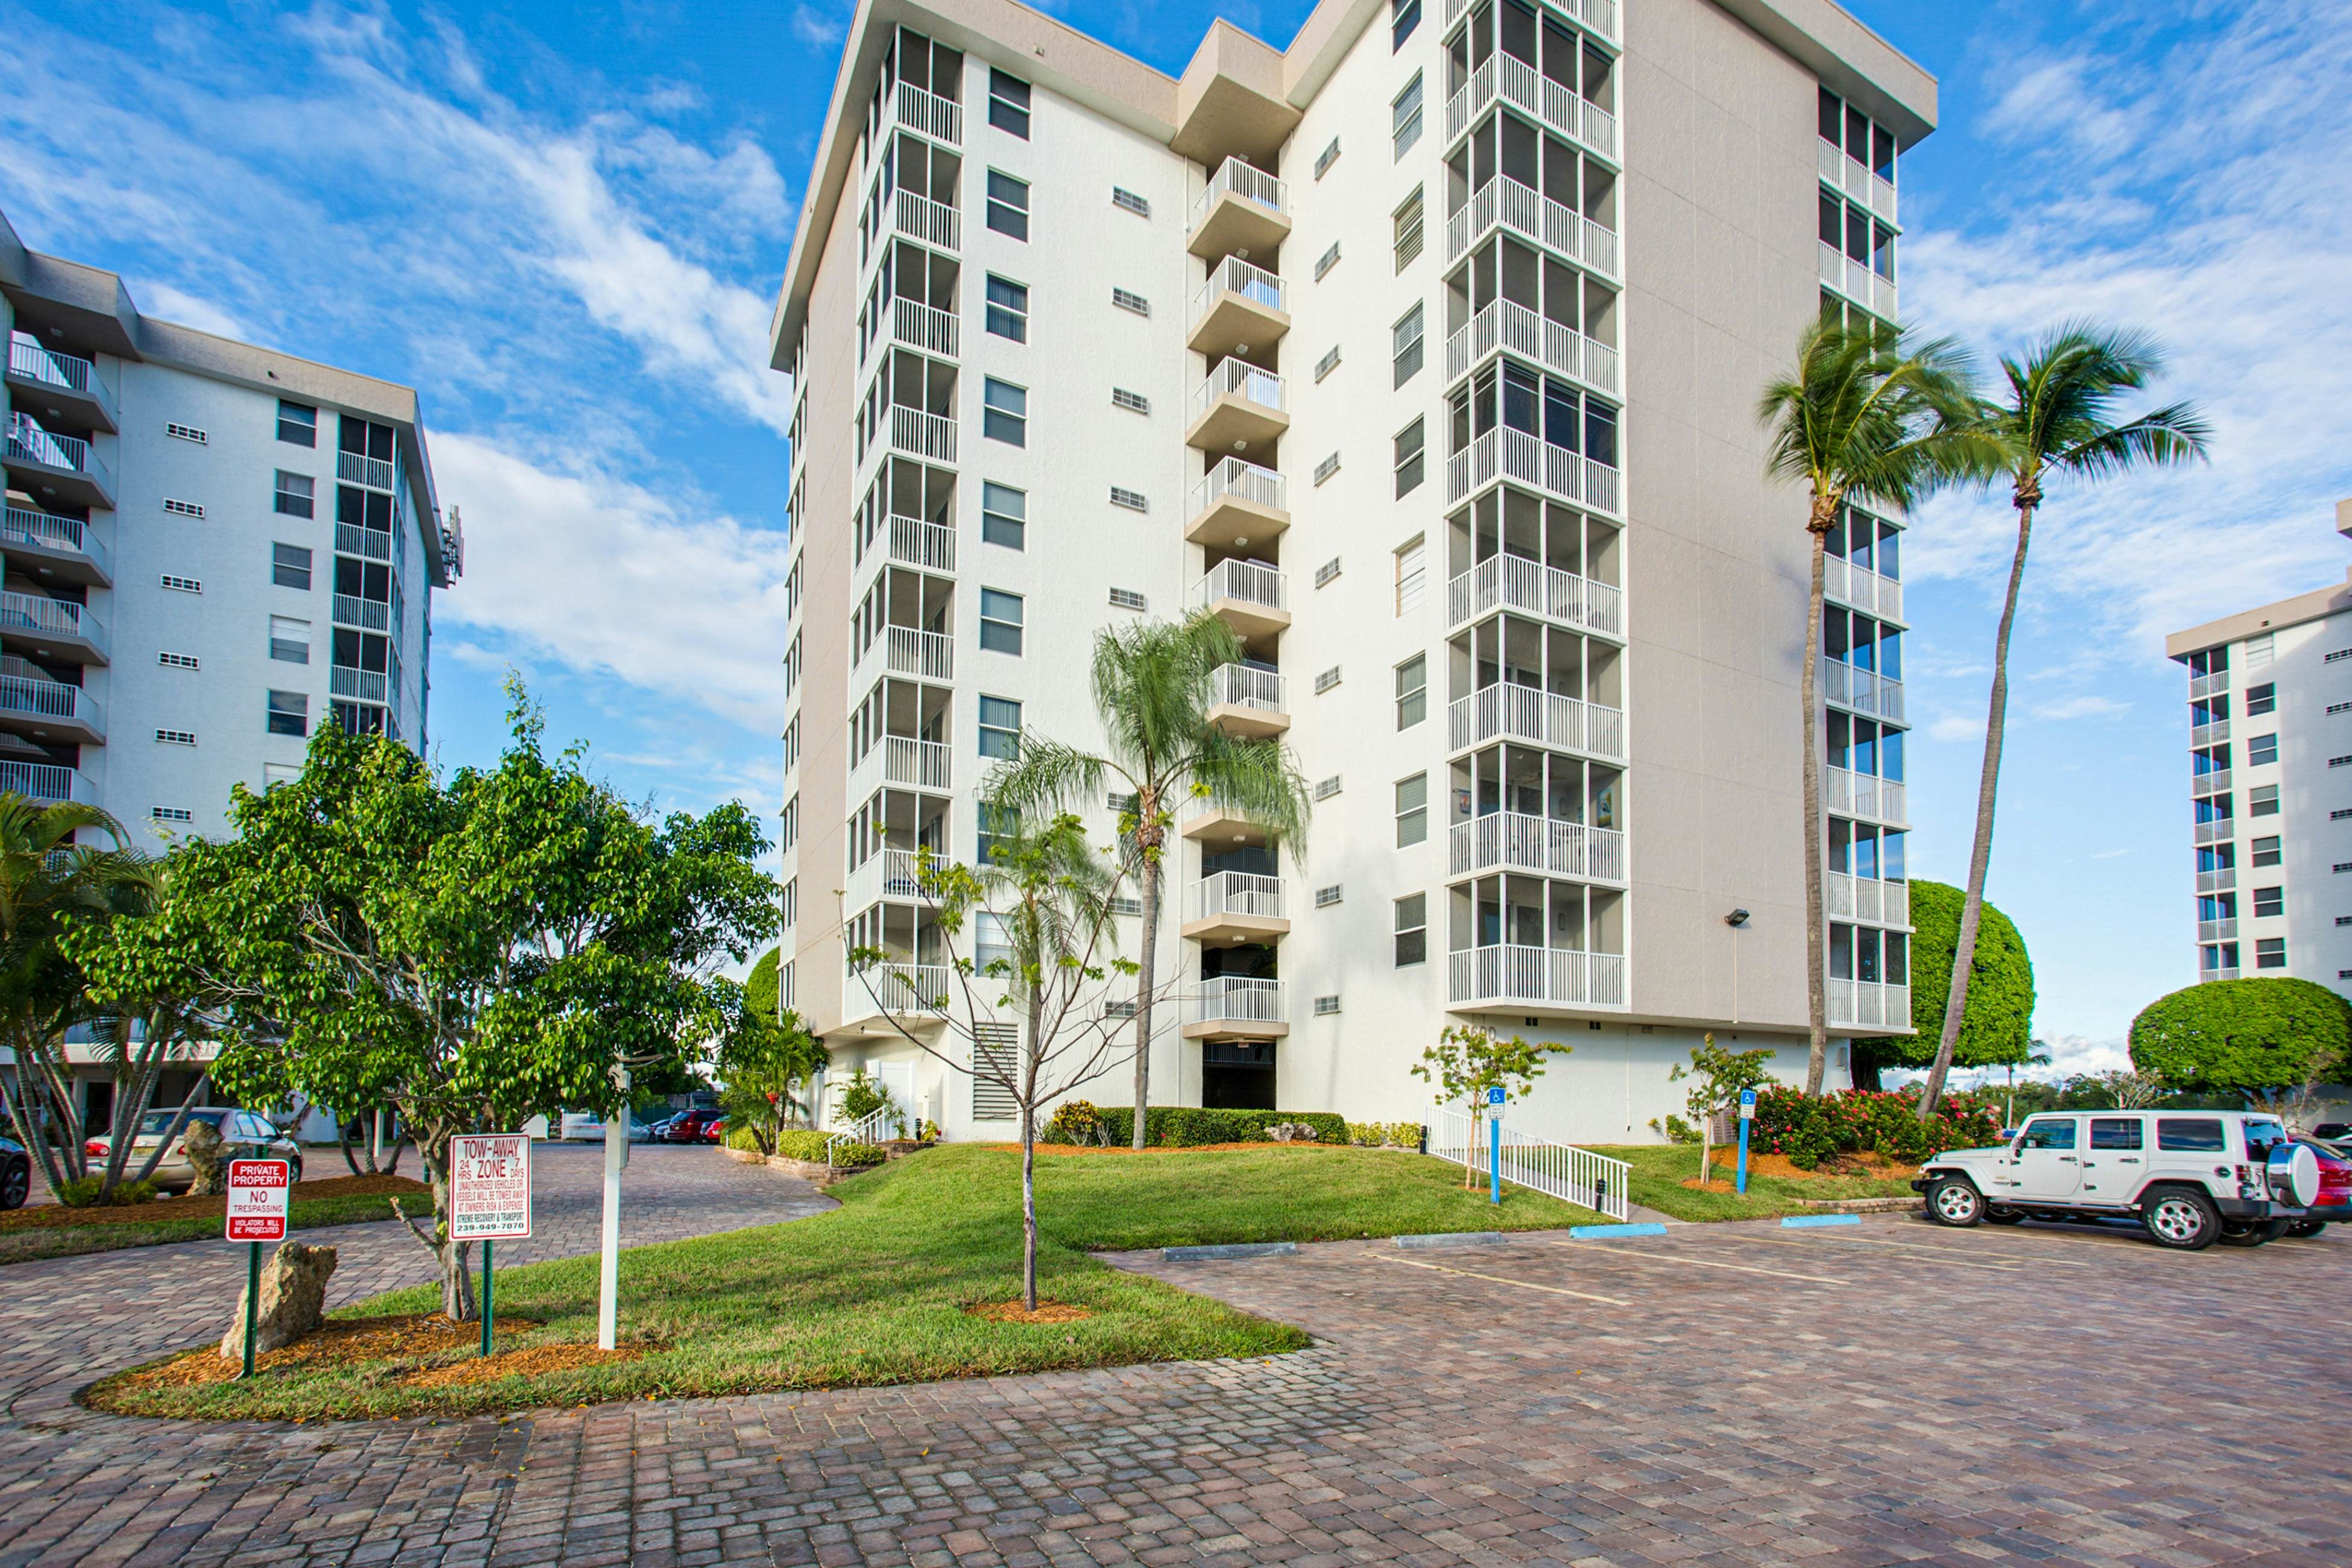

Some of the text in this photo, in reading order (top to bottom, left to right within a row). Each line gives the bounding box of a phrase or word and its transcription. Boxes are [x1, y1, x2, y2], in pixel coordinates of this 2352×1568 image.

[464, 1139, 519, 1159] TOW-AWAY
[460, 1159, 469, 1169] 24
[514, 1158, 520, 1167] 7
[240, 1165, 280, 1175] PRIVATE
[477, 1159, 505, 1178] ZONE
[511, 1168, 524, 1178] DAYS
[233, 1175, 285, 1185] PROPERTY
[458, 1170, 472, 1180] HRS
[458, 1179, 523, 1190] UNAUTHORIZED VEHICLES OR
[250, 1190, 268, 1203] NO
[457, 1189, 525, 1201] VESSELS WILL BE TOWED AWAY
[458, 1203, 463, 1212] AT
[486, 1201, 496, 1211] RISK
[498, 1201, 502, 1210] &
[503, 1200, 523, 1210] EXPENSE
[457, 1214, 473, 1223] XTREME
[475, 1213, 495, 1222] RECOVERY
[501, 1212, 524, 1221] TRANSPORT
[457, 1222, 524, 1231] 239-949-7070
